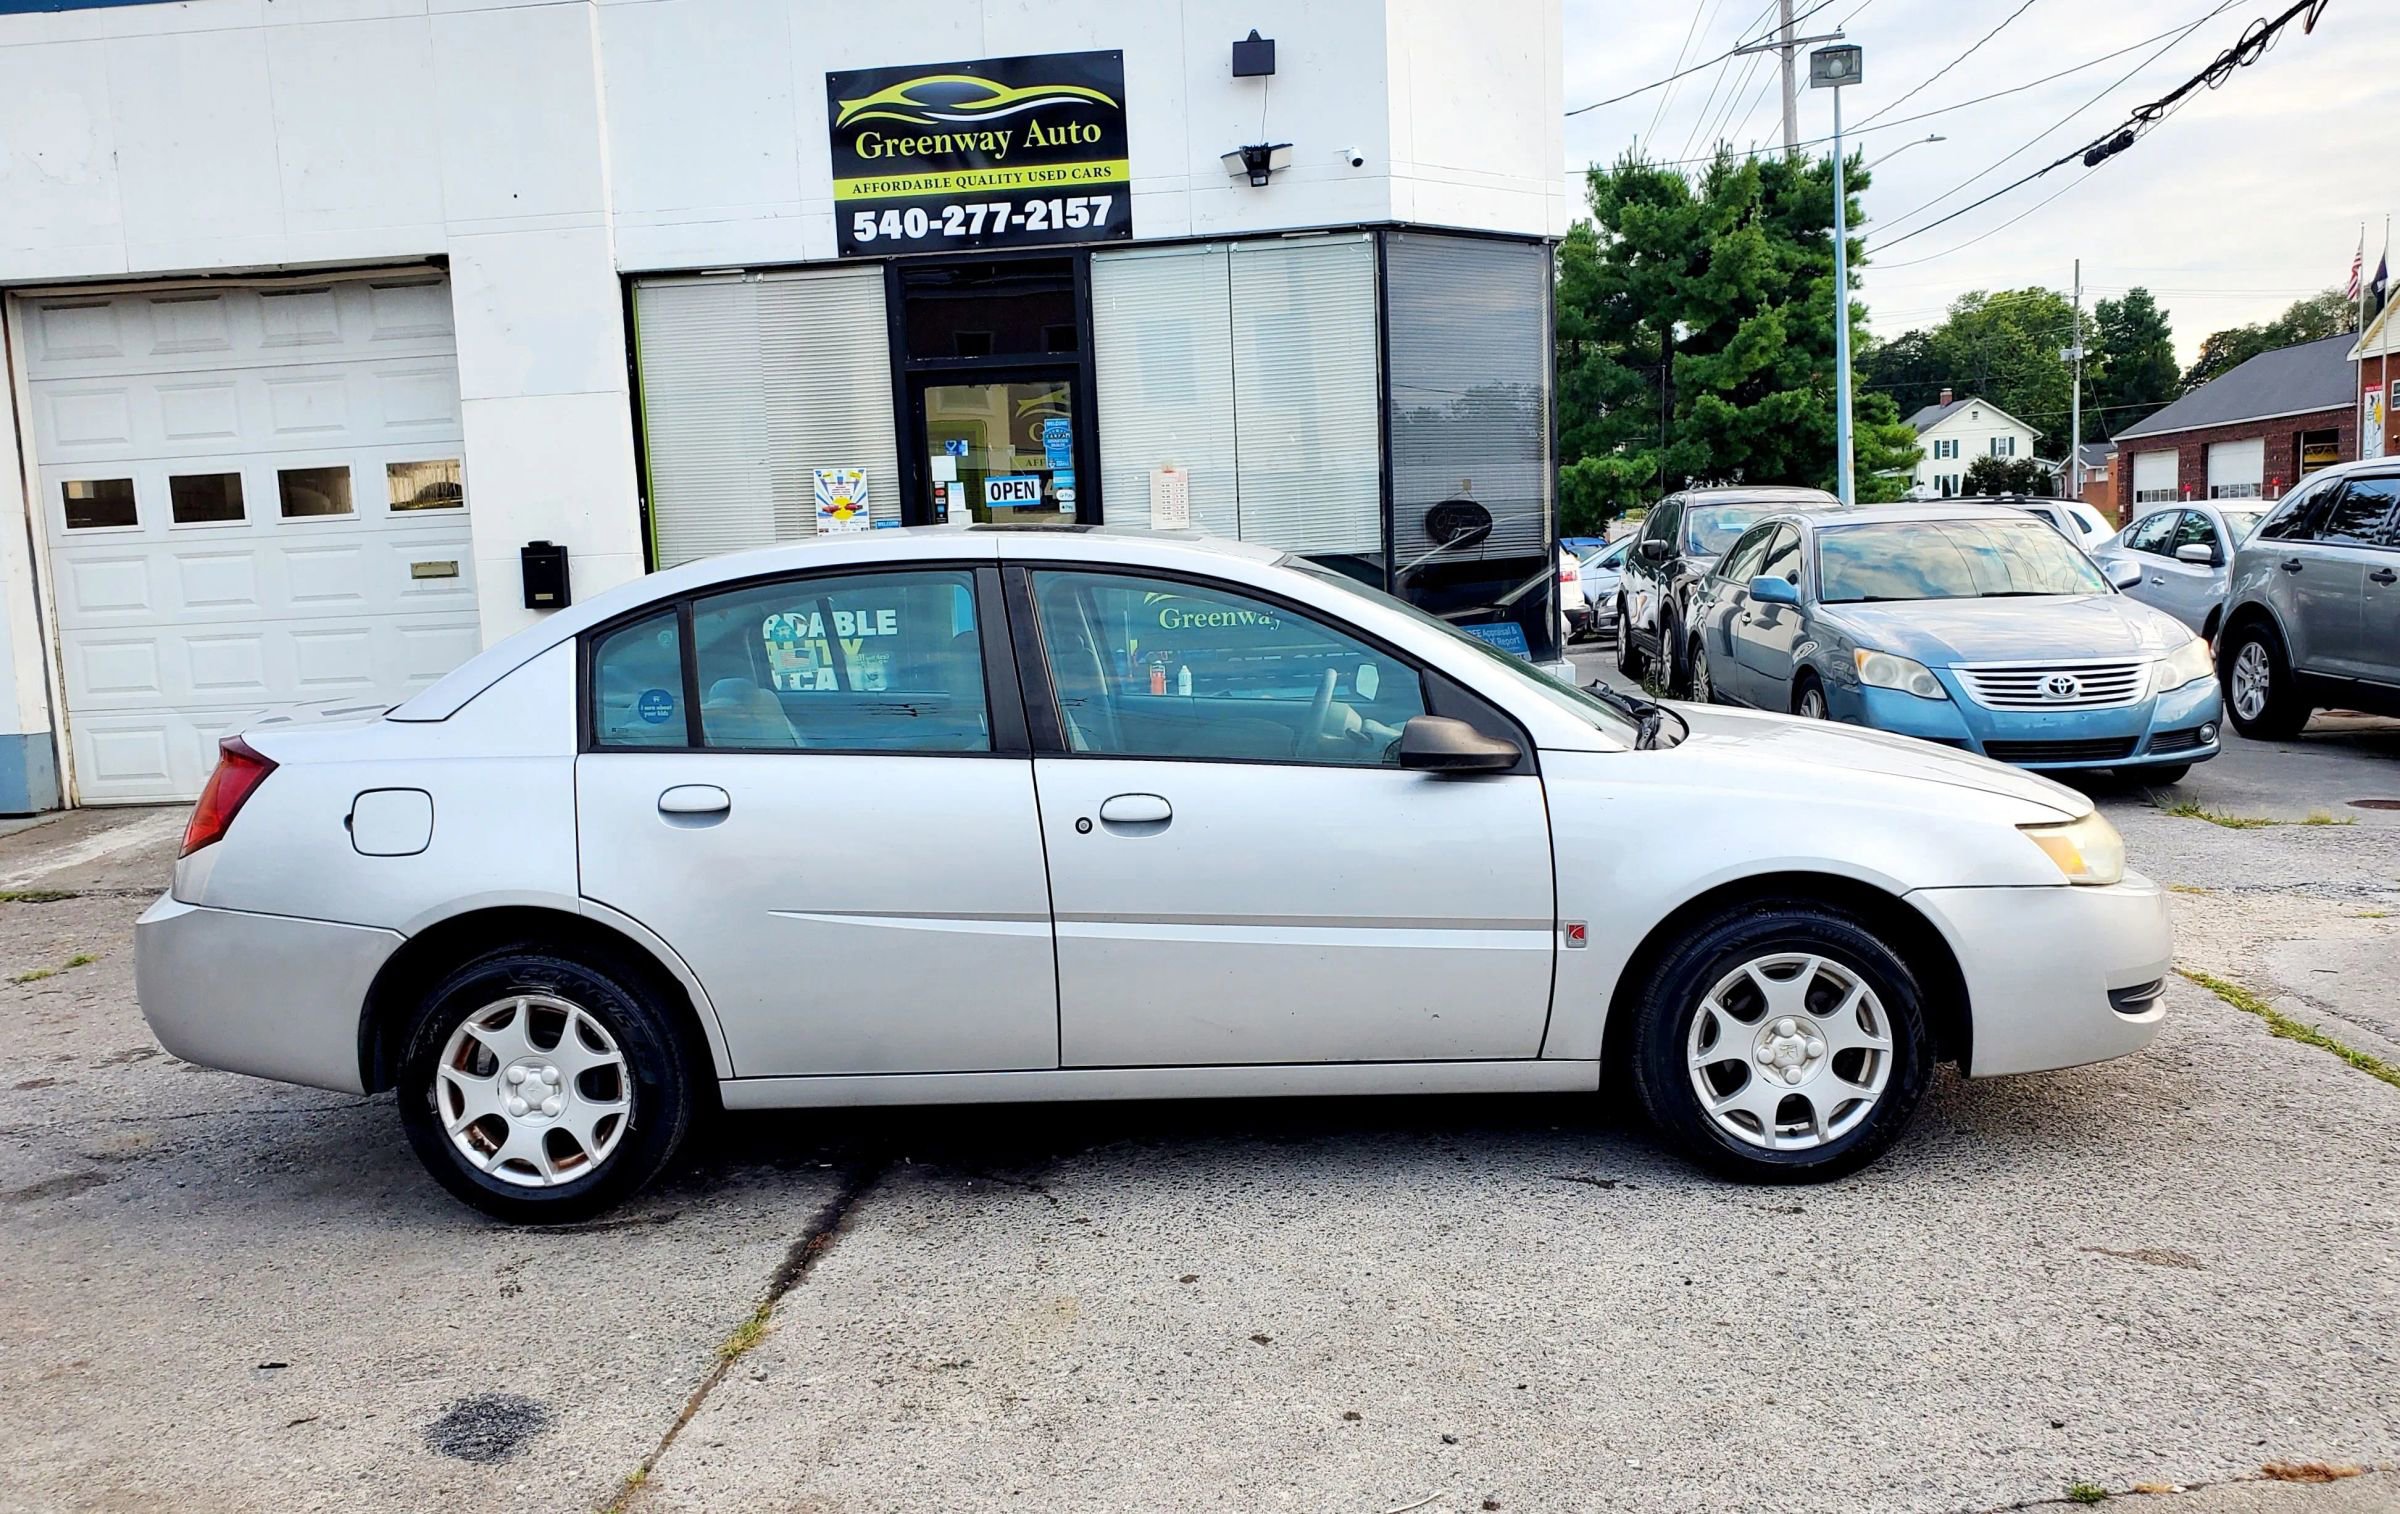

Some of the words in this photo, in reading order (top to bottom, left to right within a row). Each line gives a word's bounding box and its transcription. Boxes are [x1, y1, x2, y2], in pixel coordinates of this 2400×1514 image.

[856, 130, 1013, 159] Greenway
[1023, 119, 1102, 148] Auto
[852, 177, 952, 194] AFFORDABLE
[956, 172, 1023, 189] QUALITY
[1028, 169, 1067, 182] USED
[1071, 166, 1112, 179] CARS
[853, 195, 1113, 242] 540-277-2157
[991, 481, 1035, 501] OPEN
[1497, 637, 1520, 647] Report
